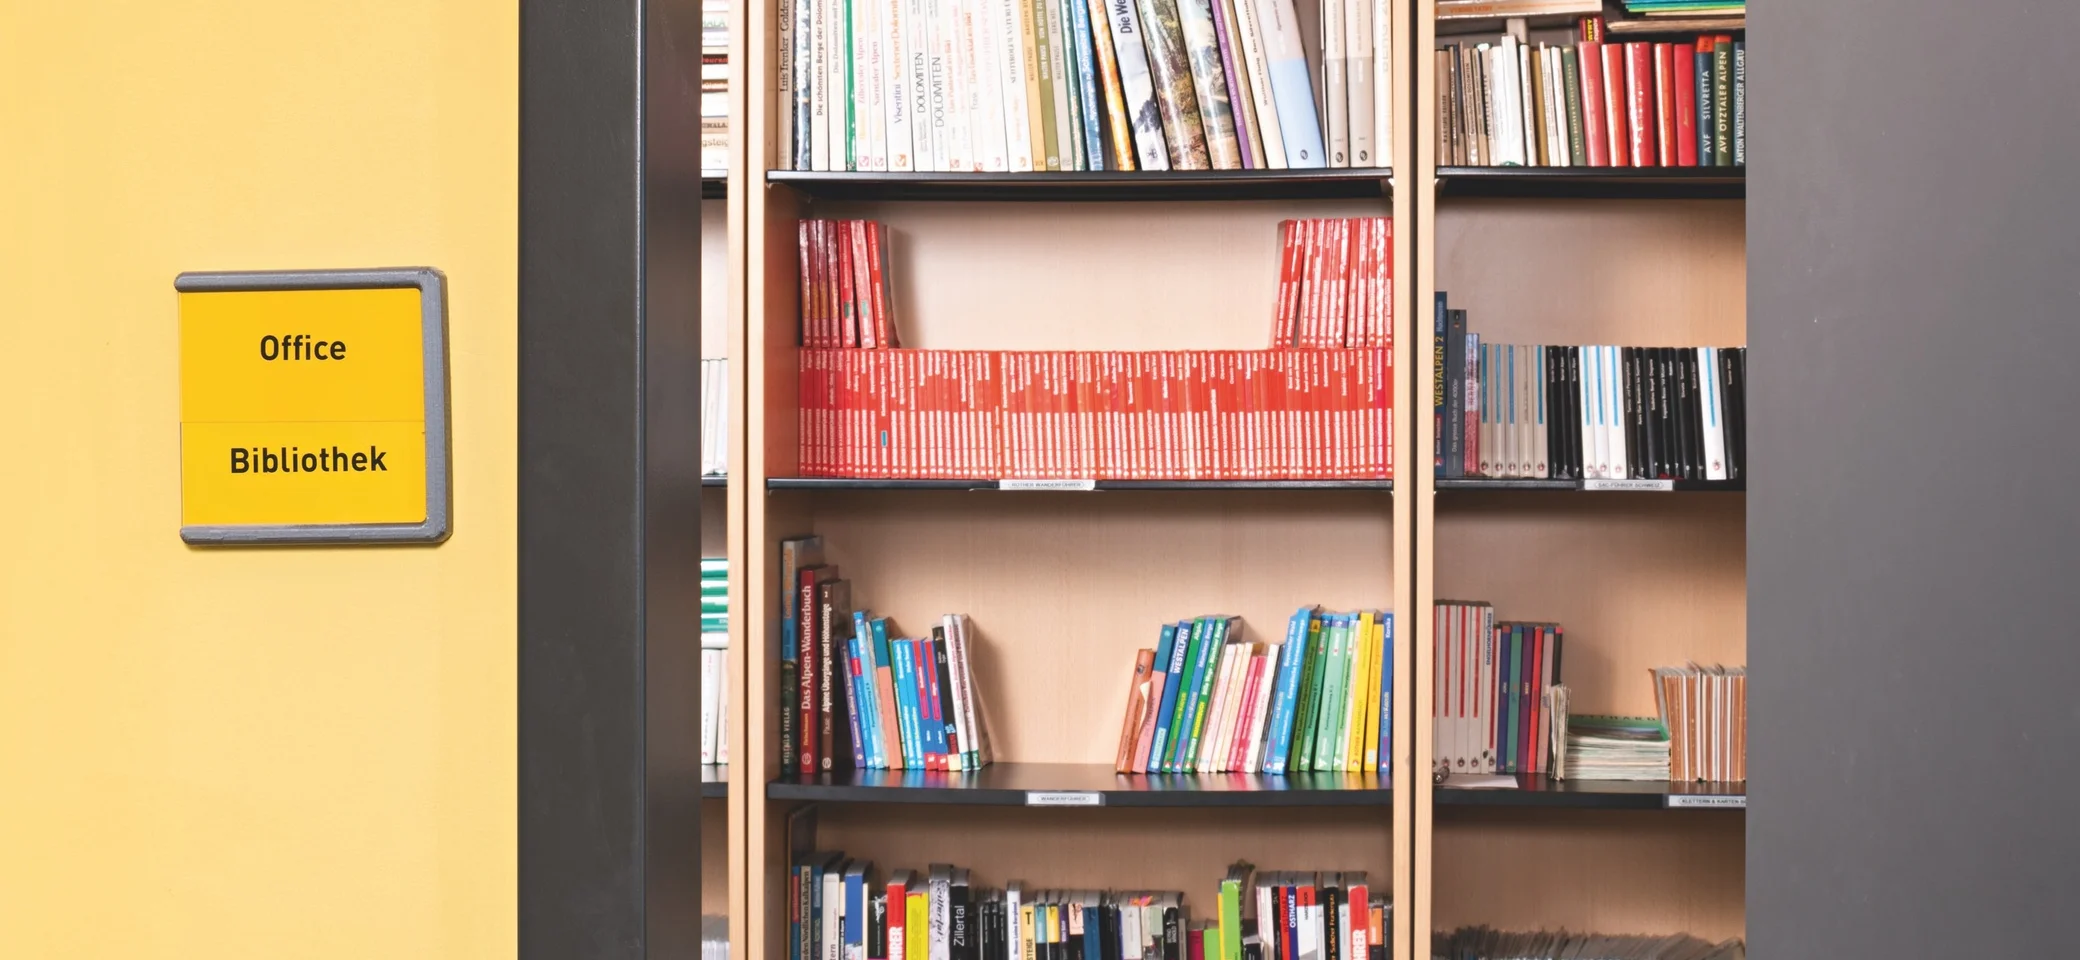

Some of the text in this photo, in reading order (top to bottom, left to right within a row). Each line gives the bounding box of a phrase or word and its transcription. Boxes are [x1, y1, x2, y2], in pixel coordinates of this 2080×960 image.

[1118, 17, 1133, 33] Die
[780, 37, 789, 73] Trenker
[816, 43, 824, 63] Berge
[1719, 51, 1727, 81] ALPEN
[780, 73, 789, 92] Luis
[915, 52, 926, 113] DOLOMITEN
[932, 57, 944, 127] DOLOMITEN
[894, 84, 903, 124] Visentini
[1702, 70, 1711, 153] AVF SILVRETTA
[1736, 82, 1744, 137] WALTENBERGER
[1719, 135, 1727, 153] AVF
[1736, 138, 1744, 163] ANTON
[260, 334, 347, 361] Office
[1435, 346, 1443, 406] WESTALPEN
[230, 446, 388, 474] Bibliothek
[801, 585, 812, 688] Alpen-Wanderbuch
[822, 604, 831, 643] Höhensteige
[1173, 629, 1189, 674] WESTALPEN
[821, 657, 831, 691] Übergänge
[801, 690, 811, 709] Das
[822, 692, 831, 712] Alpine
[954, 905, 964, 946] Zillertal
